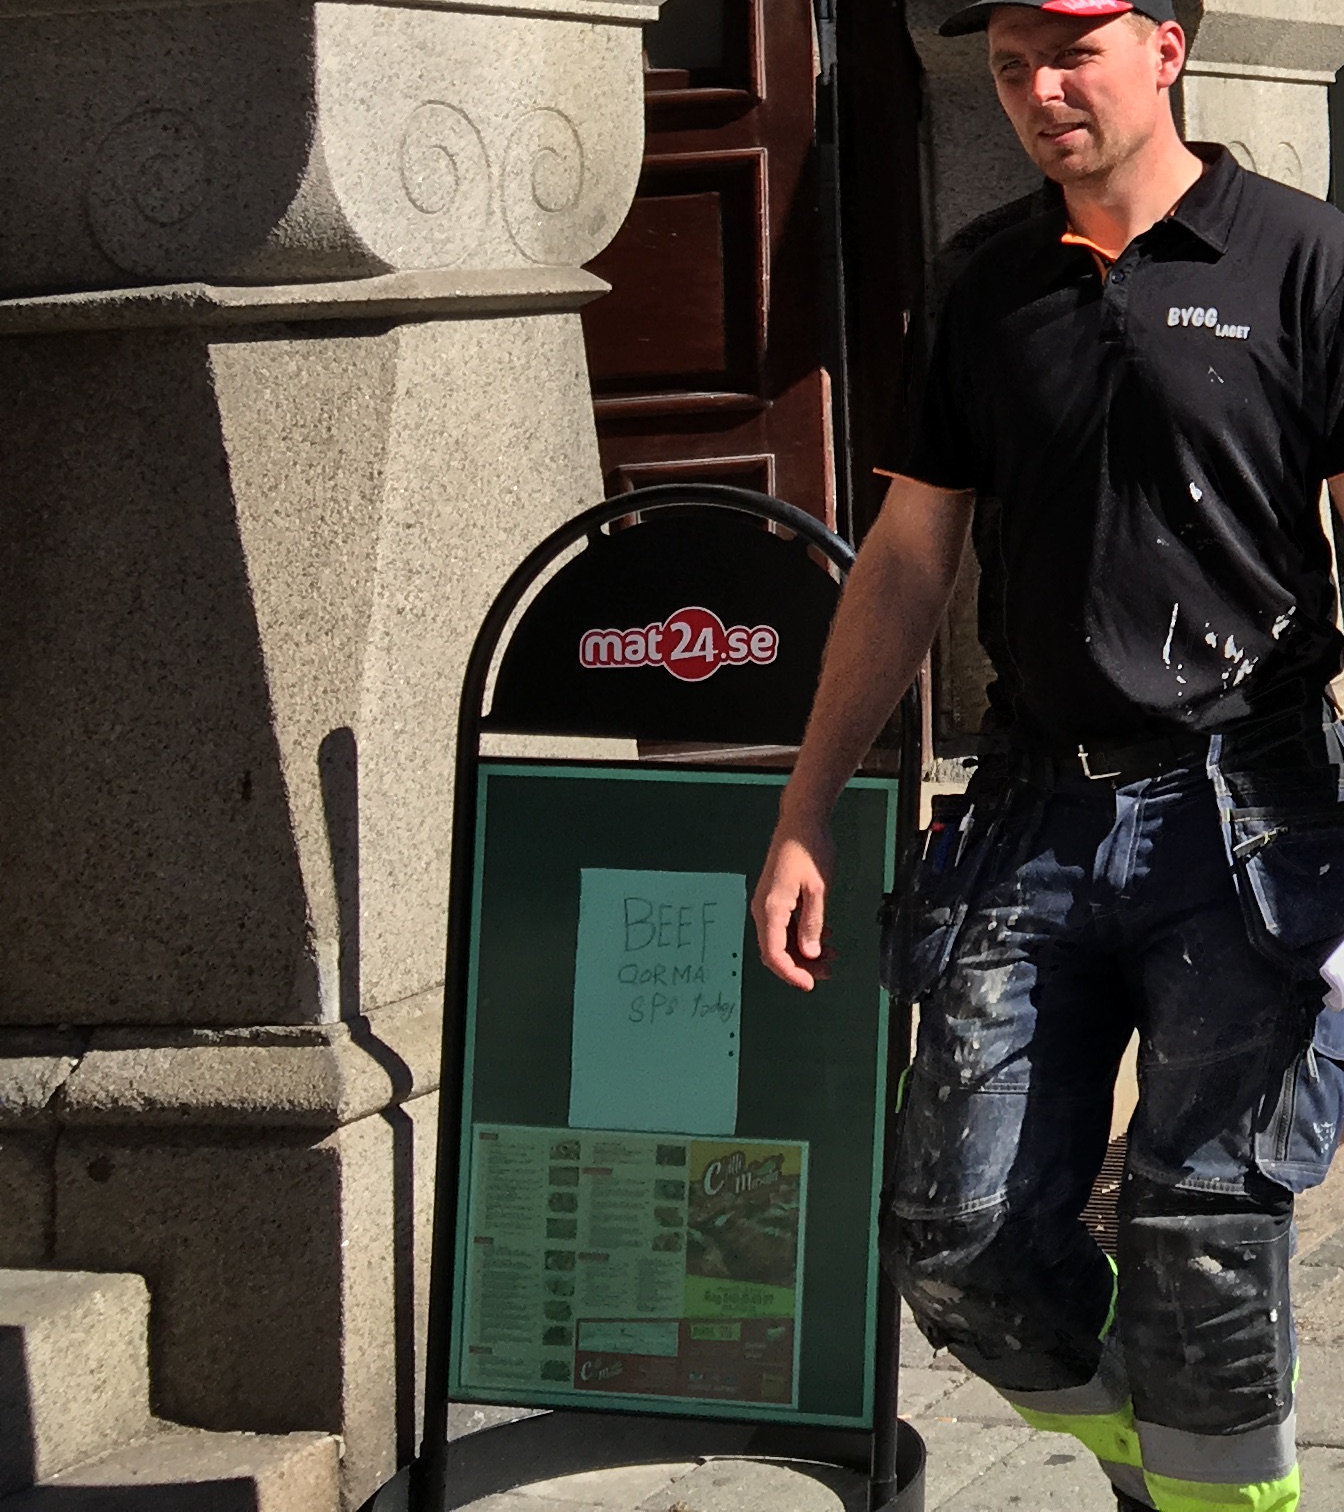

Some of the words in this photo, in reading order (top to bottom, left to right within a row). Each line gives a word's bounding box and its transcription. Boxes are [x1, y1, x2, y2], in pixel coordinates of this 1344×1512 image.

[1167, 306, 1219, 328] BYGG
[1215, 324, 1251, 339] LAGET
[585, 621, 774, 663] mat24.se
[623, 896, 718, 963] BEEF
